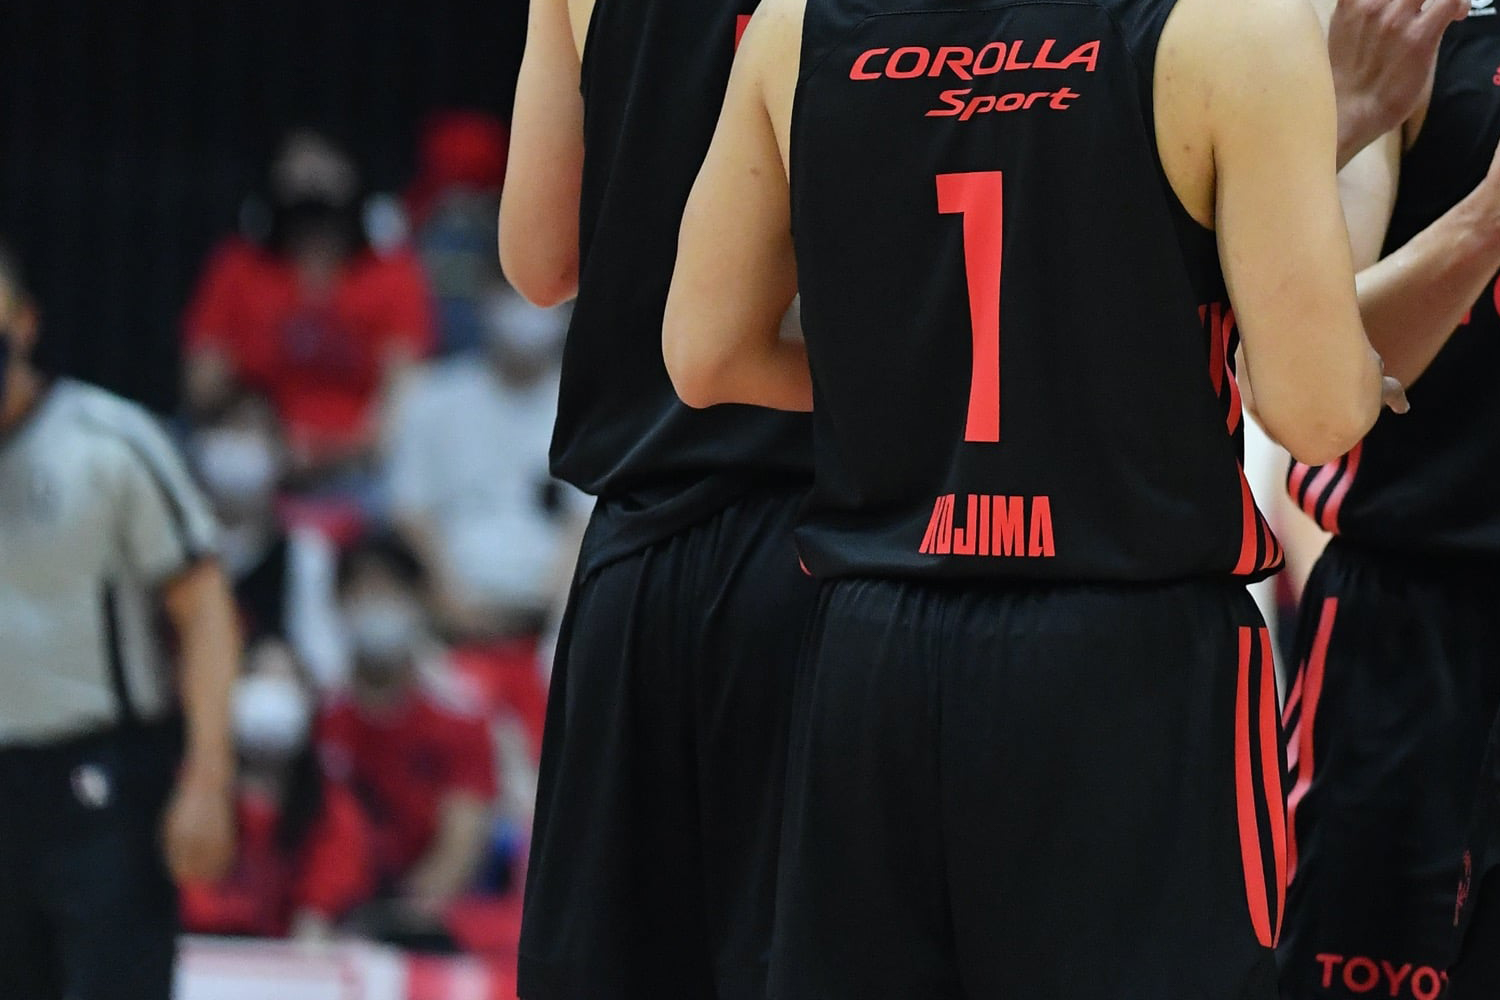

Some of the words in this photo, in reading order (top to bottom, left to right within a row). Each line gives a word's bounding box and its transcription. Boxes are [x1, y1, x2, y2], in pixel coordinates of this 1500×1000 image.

[849, 39, 1100, 81] COROLLA
[924, 87, 1081, 122] Sport
[936, 170, 1003, 443] 1
[918, 493, 1056, 558] KOJIMA
[1315, 953, 1450, 1000] TOYO
